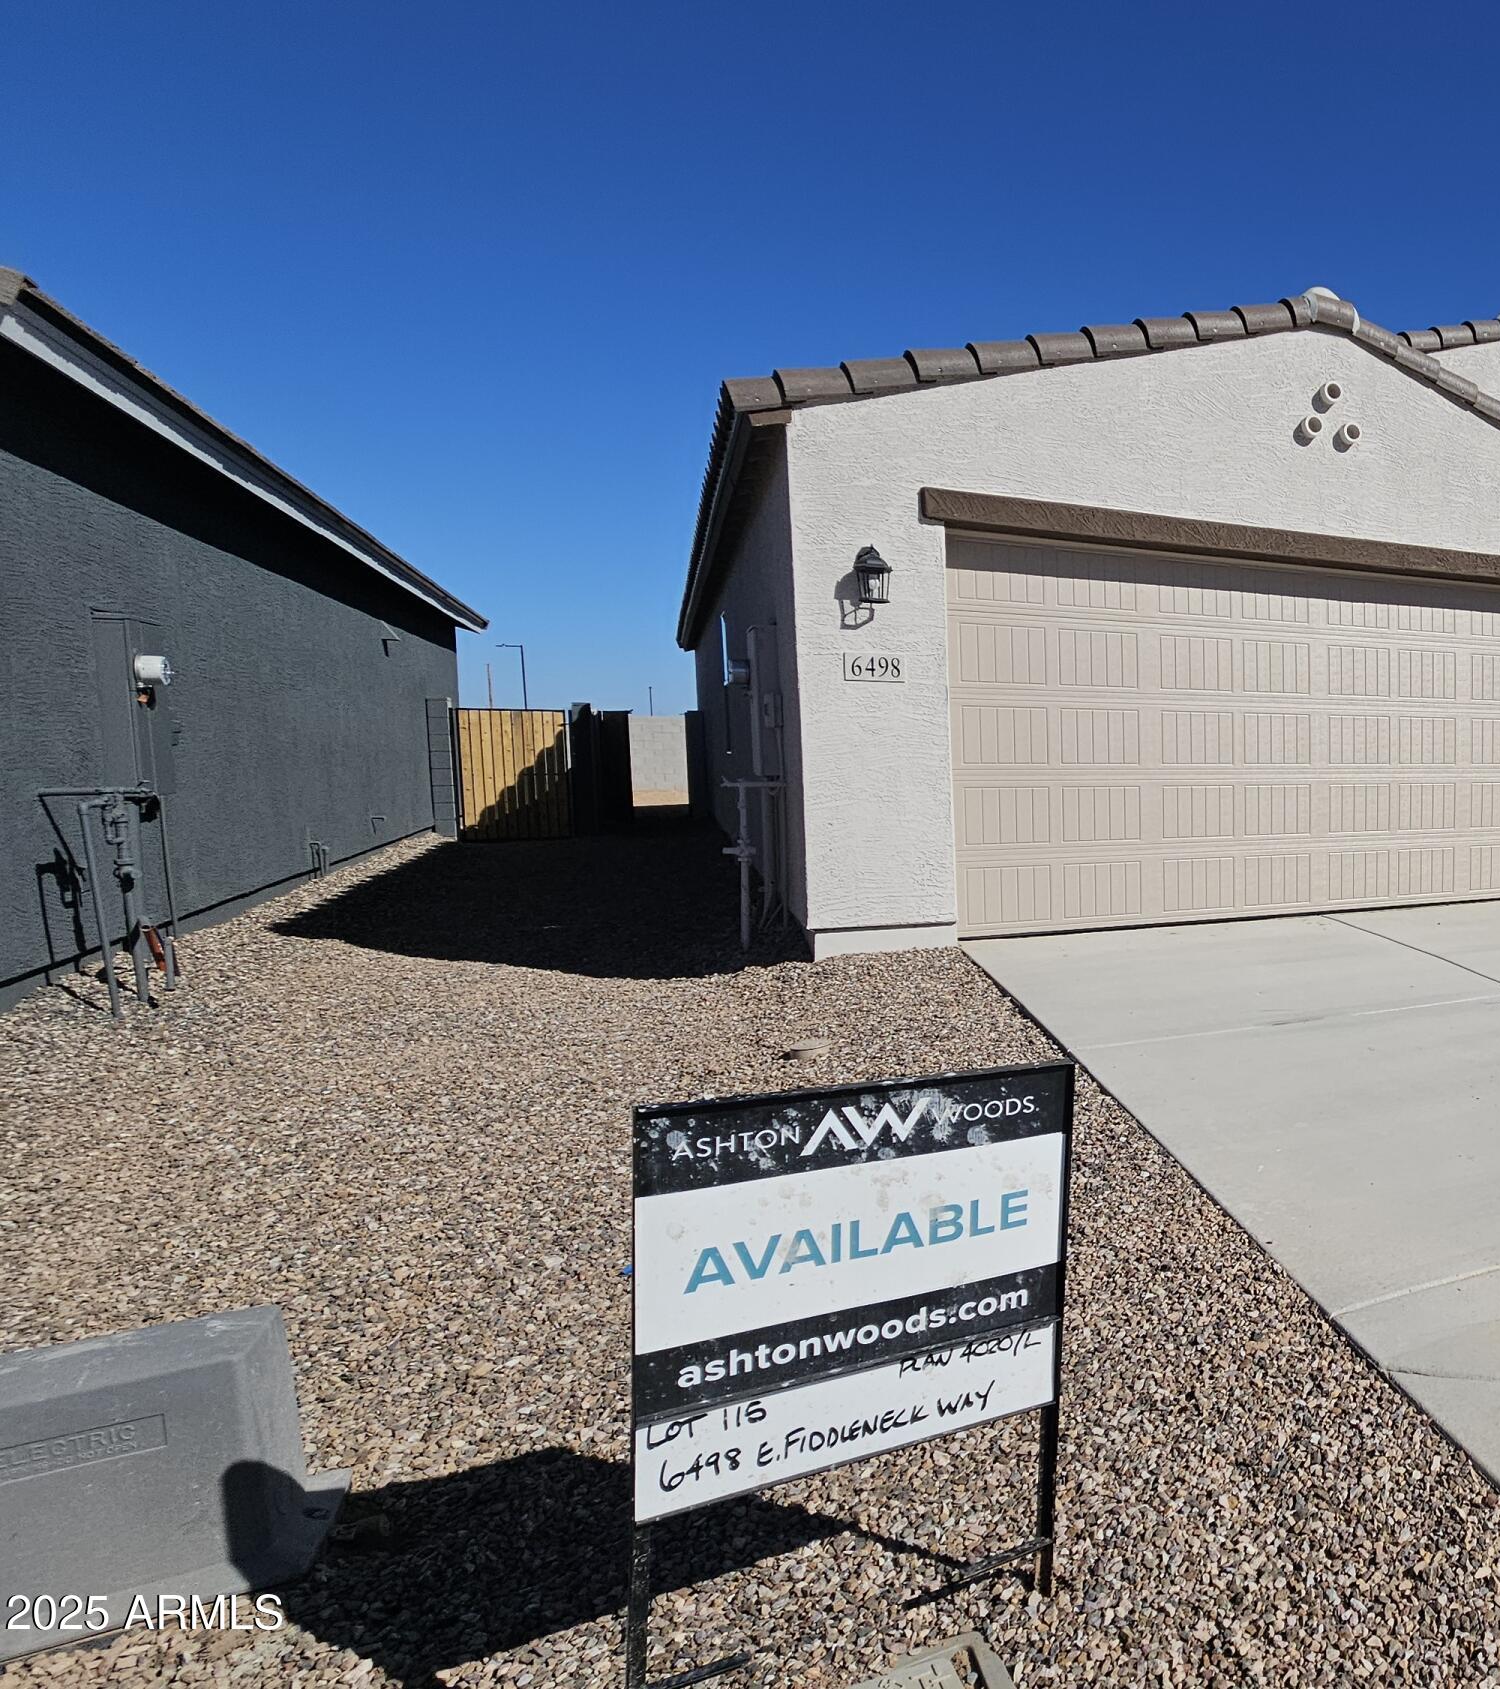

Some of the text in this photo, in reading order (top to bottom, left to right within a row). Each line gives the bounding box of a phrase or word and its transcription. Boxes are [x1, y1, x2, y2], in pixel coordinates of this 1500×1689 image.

[851, 655, 901, 678] 6498
[671, 1125, 800, 1161] ASHTON
[683, 1188, 1030, 1294] AVAILABLE
[677, 1287, 1029, 1389] ashtonwoods.com
[898, 1350, 955, 1379] PLAN
[646, 1400, 768, 1451] LOT 115
[659, 1446, 742, 1493] 6498
[936, 1379, 996, 1419] WAY
